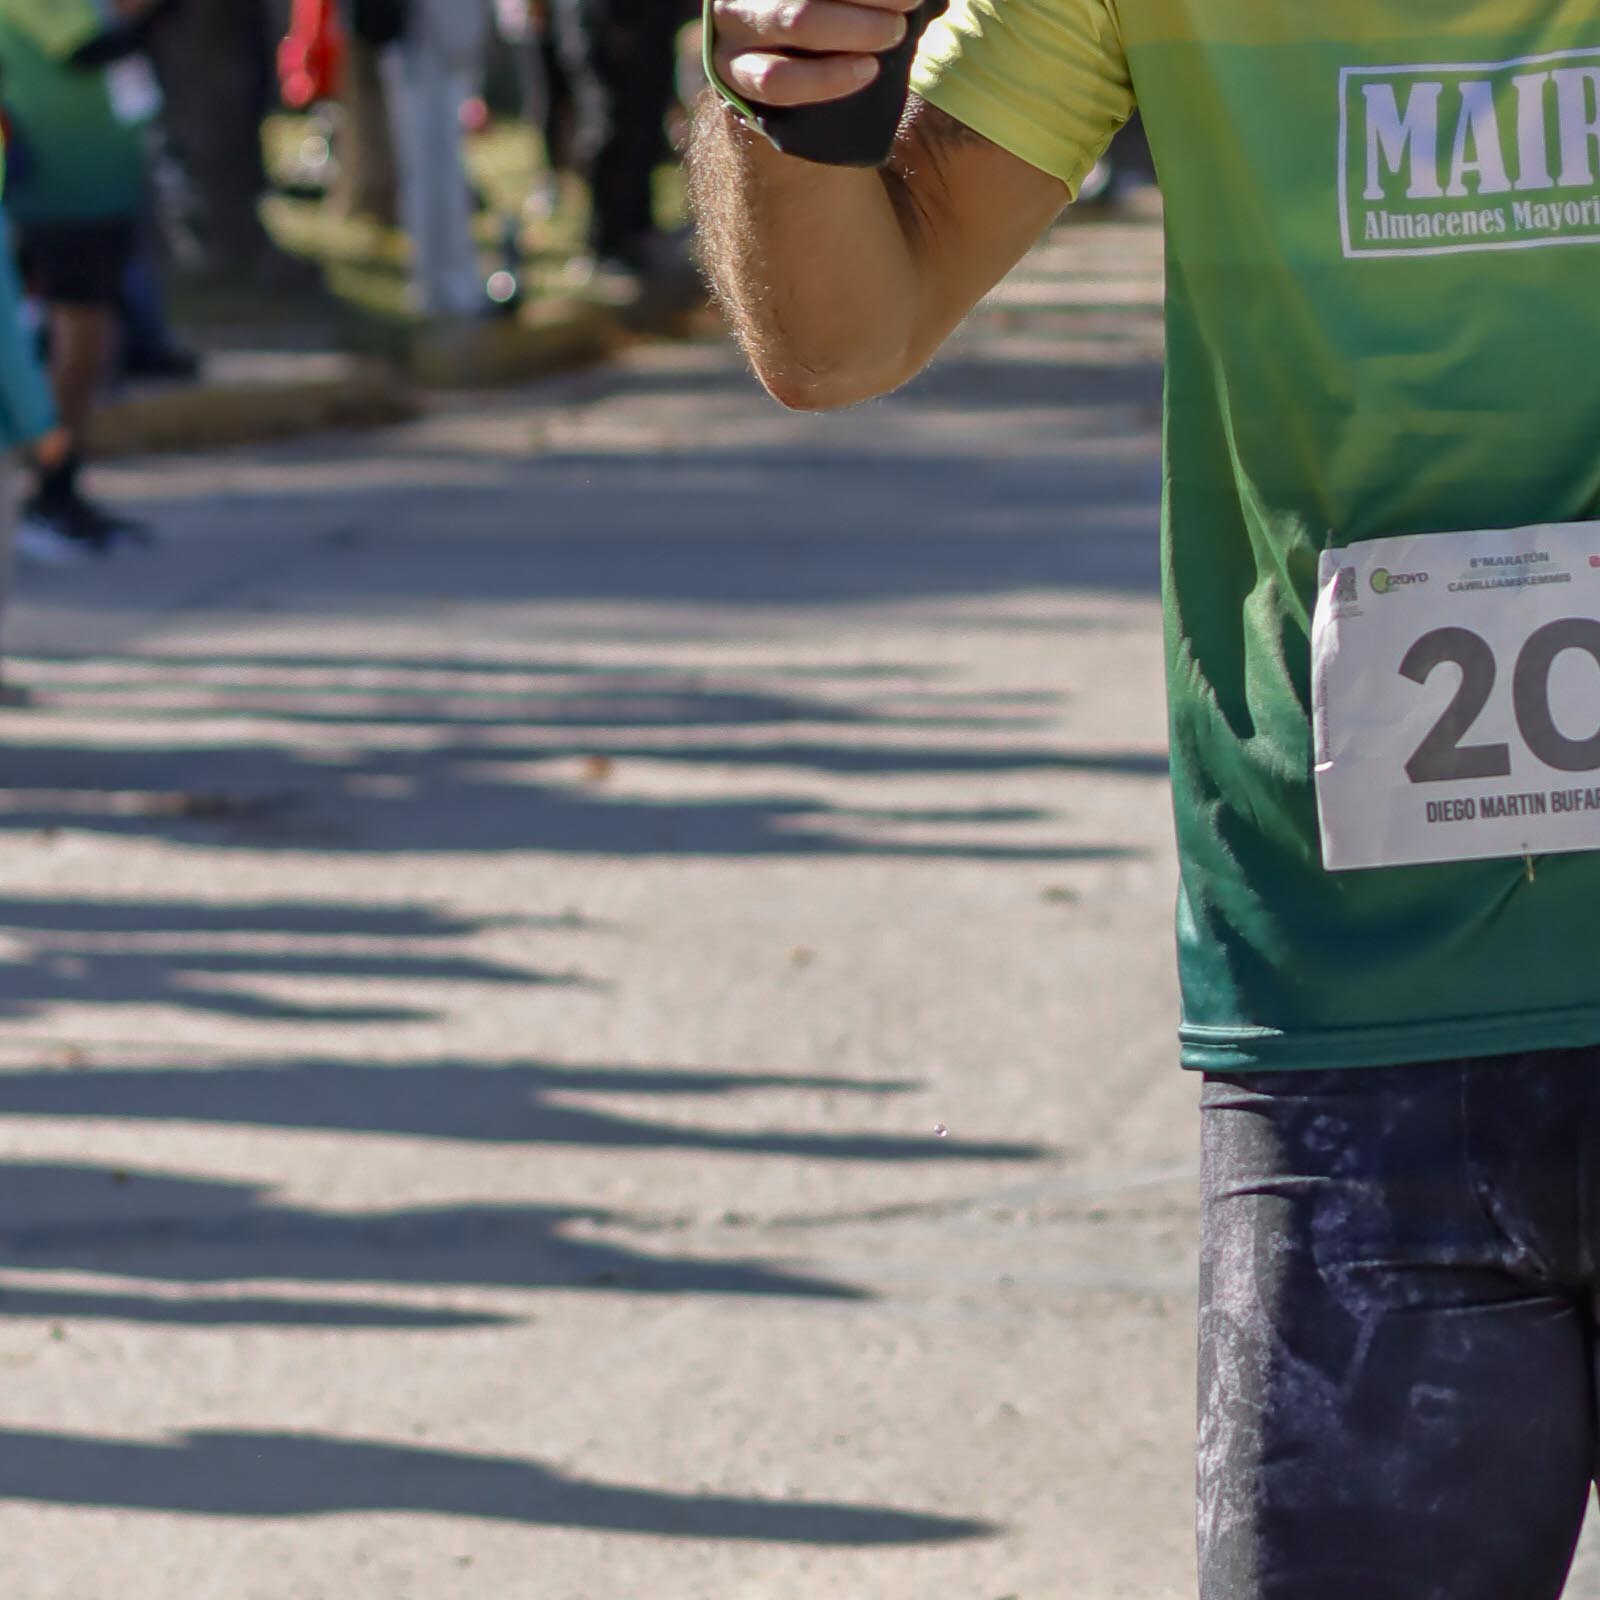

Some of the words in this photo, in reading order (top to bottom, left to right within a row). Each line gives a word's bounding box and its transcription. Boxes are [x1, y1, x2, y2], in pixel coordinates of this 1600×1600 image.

[1364, 204, 1506, 241] Almacenes
[1426, 794, 1476, 824] DIEGO
[1480, 789, 1547, 819] MARTIN
